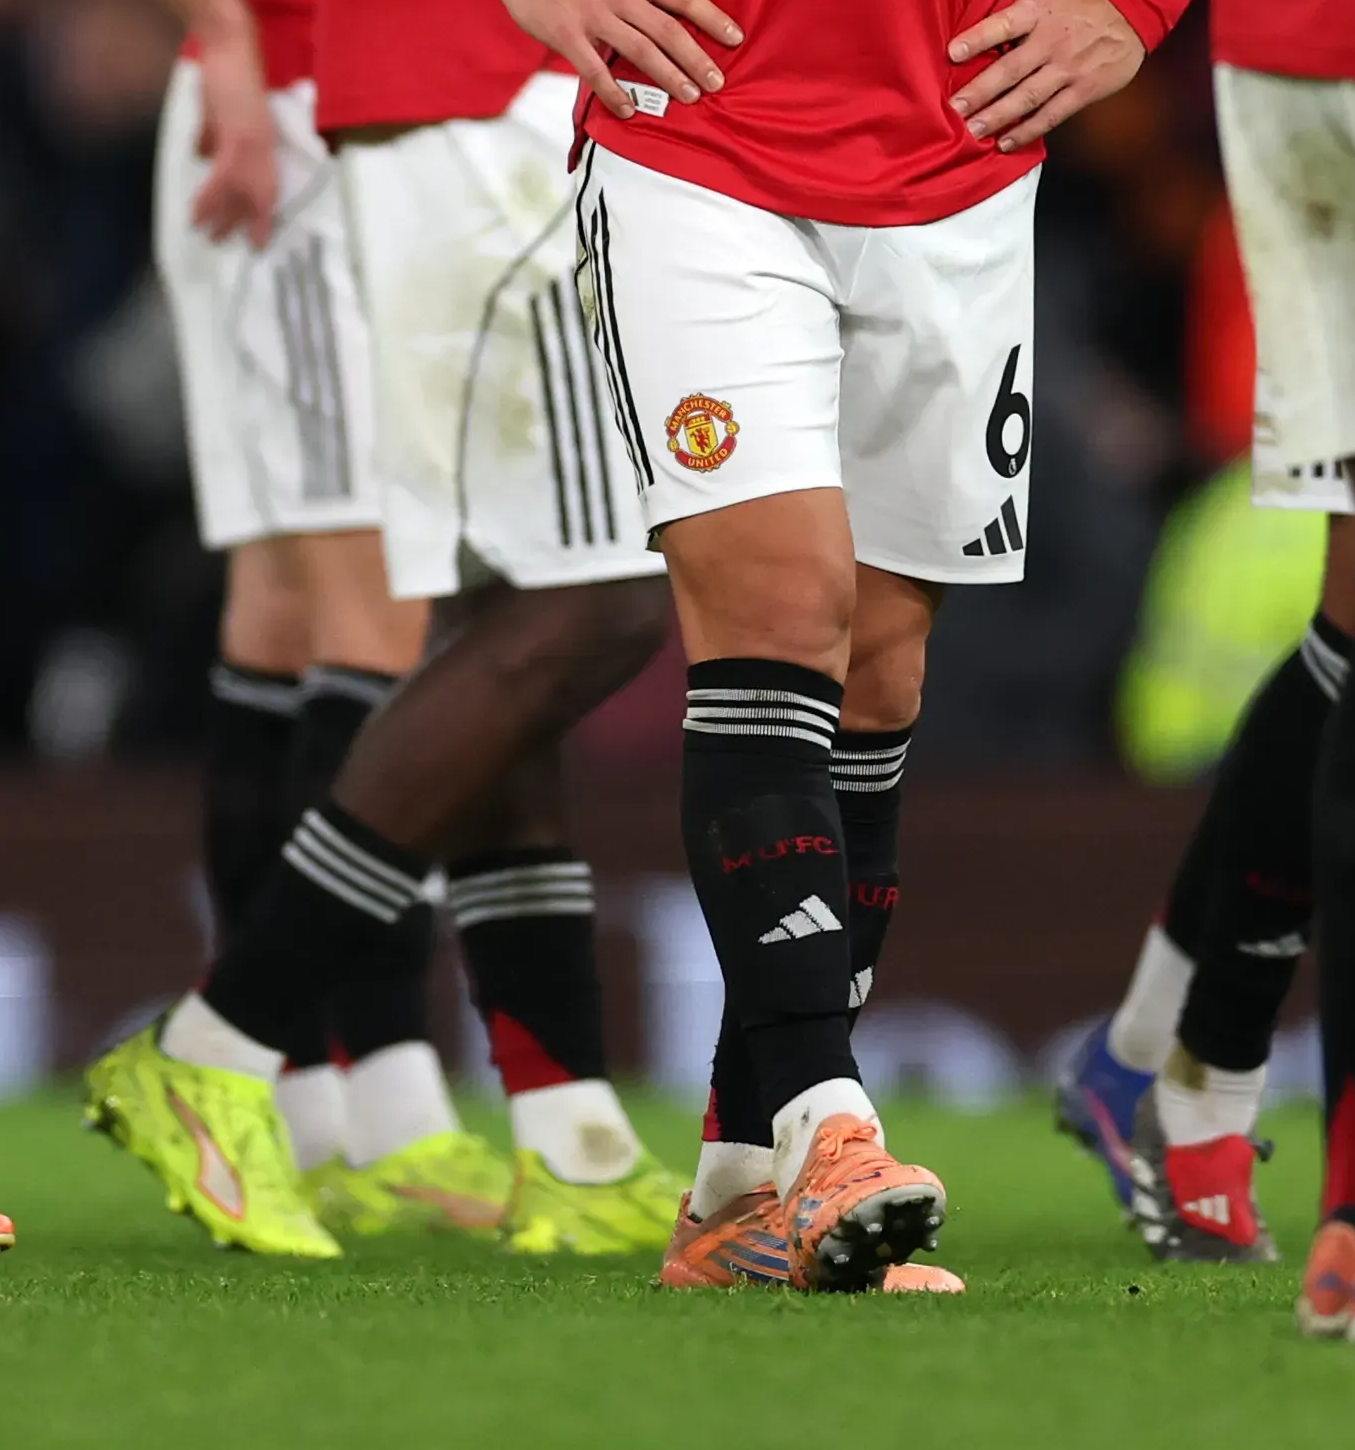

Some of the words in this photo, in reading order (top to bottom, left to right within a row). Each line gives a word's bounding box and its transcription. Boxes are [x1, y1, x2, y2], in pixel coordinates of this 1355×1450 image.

[670, 399, 727, 431] MANCHESTER
[985, 343, 1031, 478] 6
[687, 447, 728, 467] UNITED
